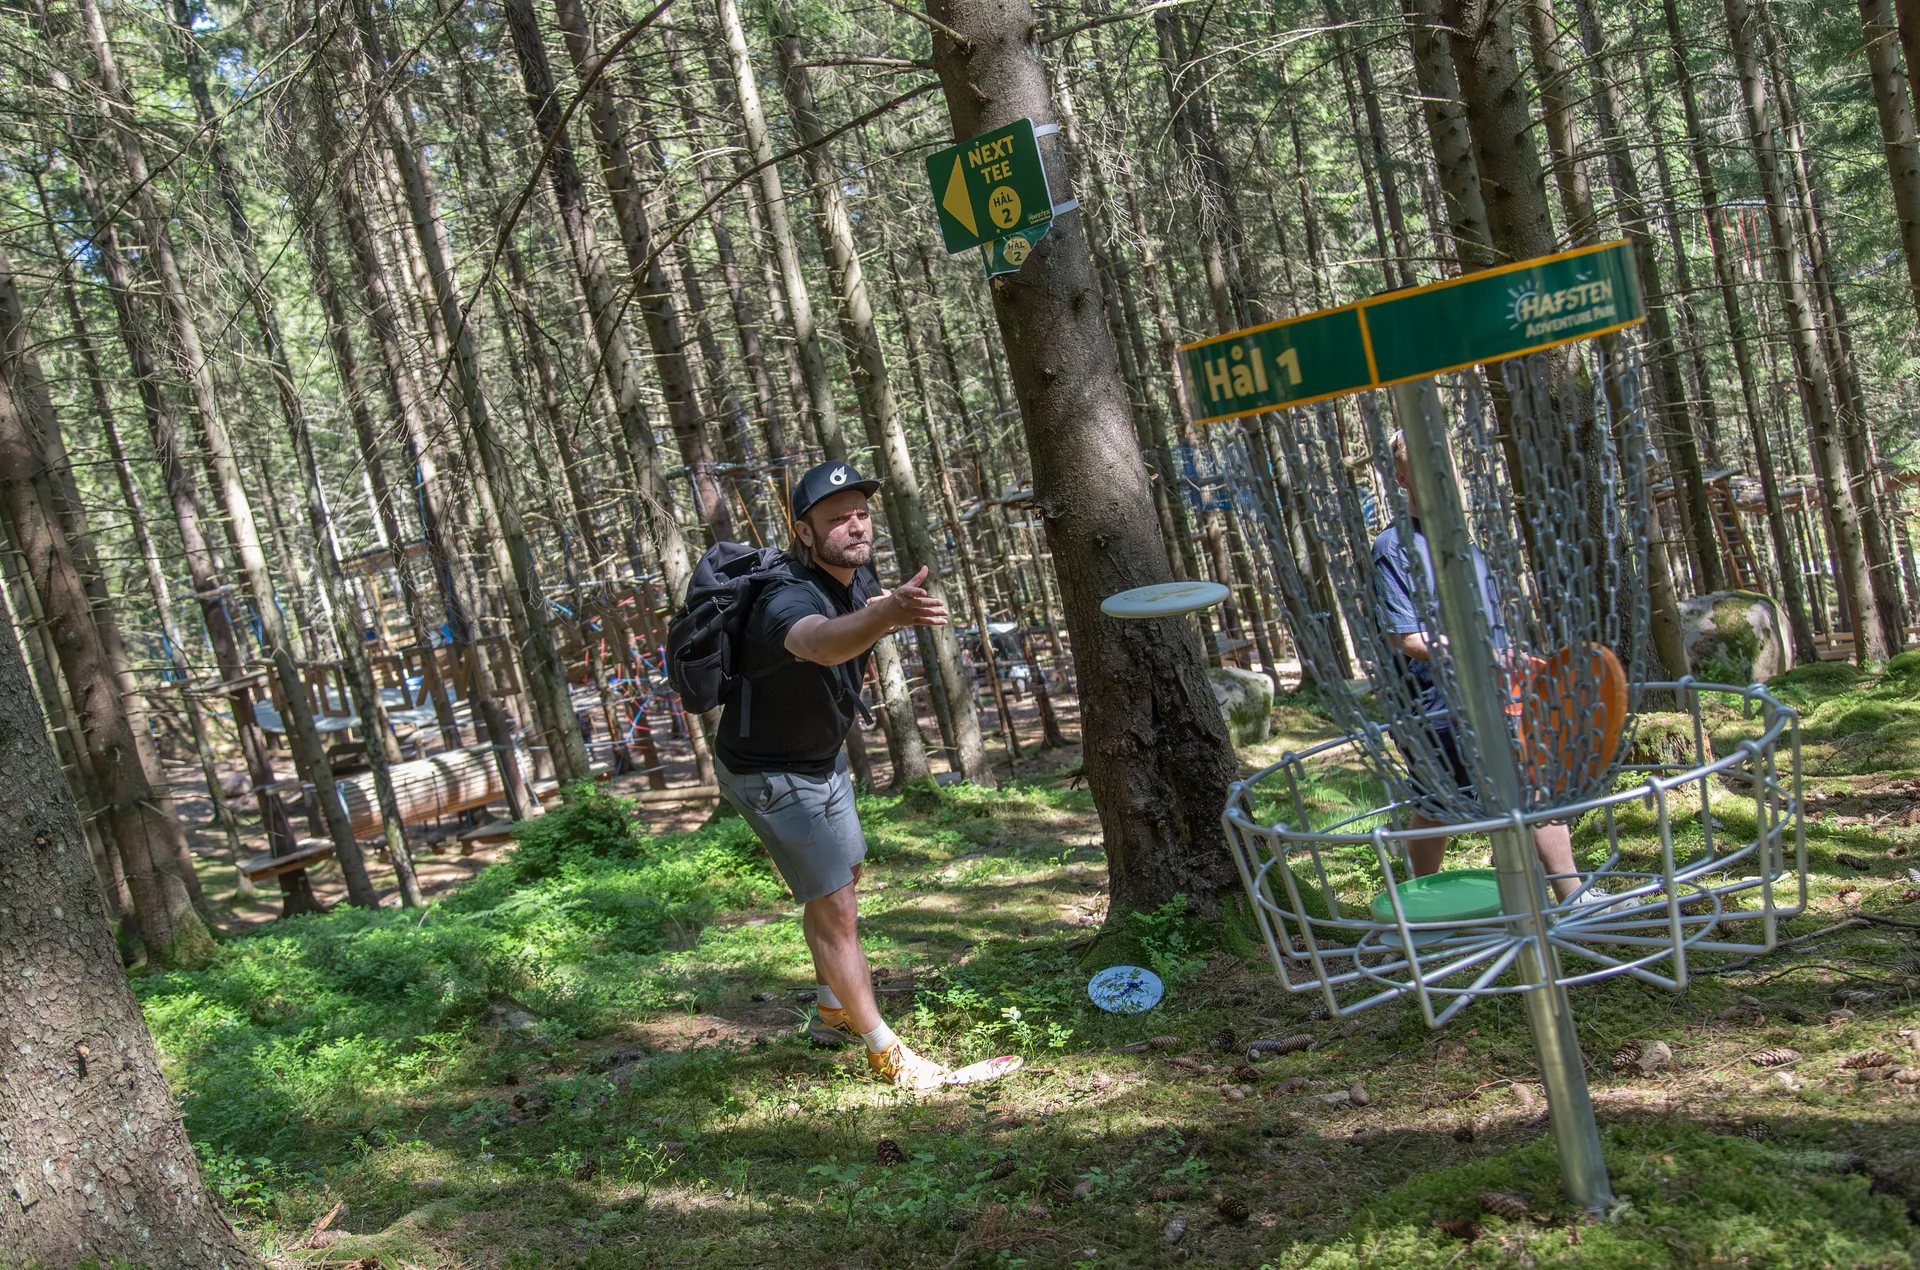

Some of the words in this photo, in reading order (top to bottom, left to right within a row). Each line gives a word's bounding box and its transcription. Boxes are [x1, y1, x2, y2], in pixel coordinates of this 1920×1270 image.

[967, 135, 1015, 168] NEXT
[980, 159, 1013, 184] TEE
[993, 191, 1014, 208] HÅL
[1001, 208, 1013, 224] 2
[1013, 251, 1022, 262] 2
[1521, 278, 1613, 321] HAFSTEN
[1204, 345, 1269, 402] Hål
[1275, 347, 1303, 385] 1
